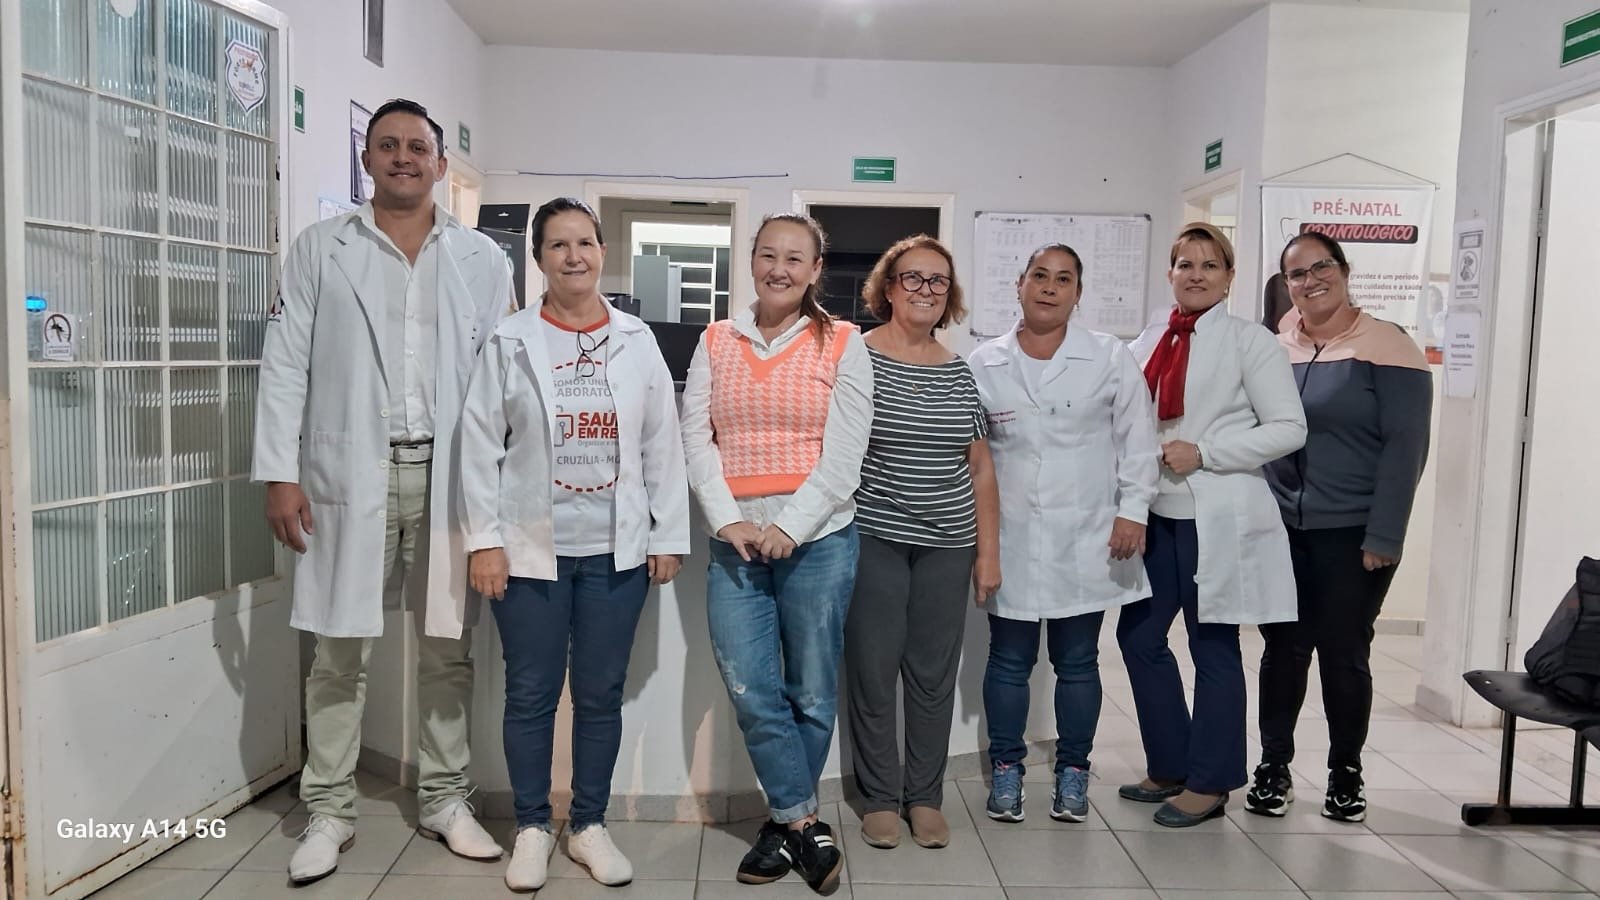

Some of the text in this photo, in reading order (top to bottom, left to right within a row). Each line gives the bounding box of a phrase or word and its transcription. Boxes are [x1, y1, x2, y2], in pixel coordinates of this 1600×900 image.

[1312, 198, 1402, 216] PRÉ-NATAL
[1394, 273, 1419, 281] período
[578, 409, 617, 427] SAÚ
[578, 427, 598, 439] EM
[557, 453, 600, 465] CRUZÍLIA
